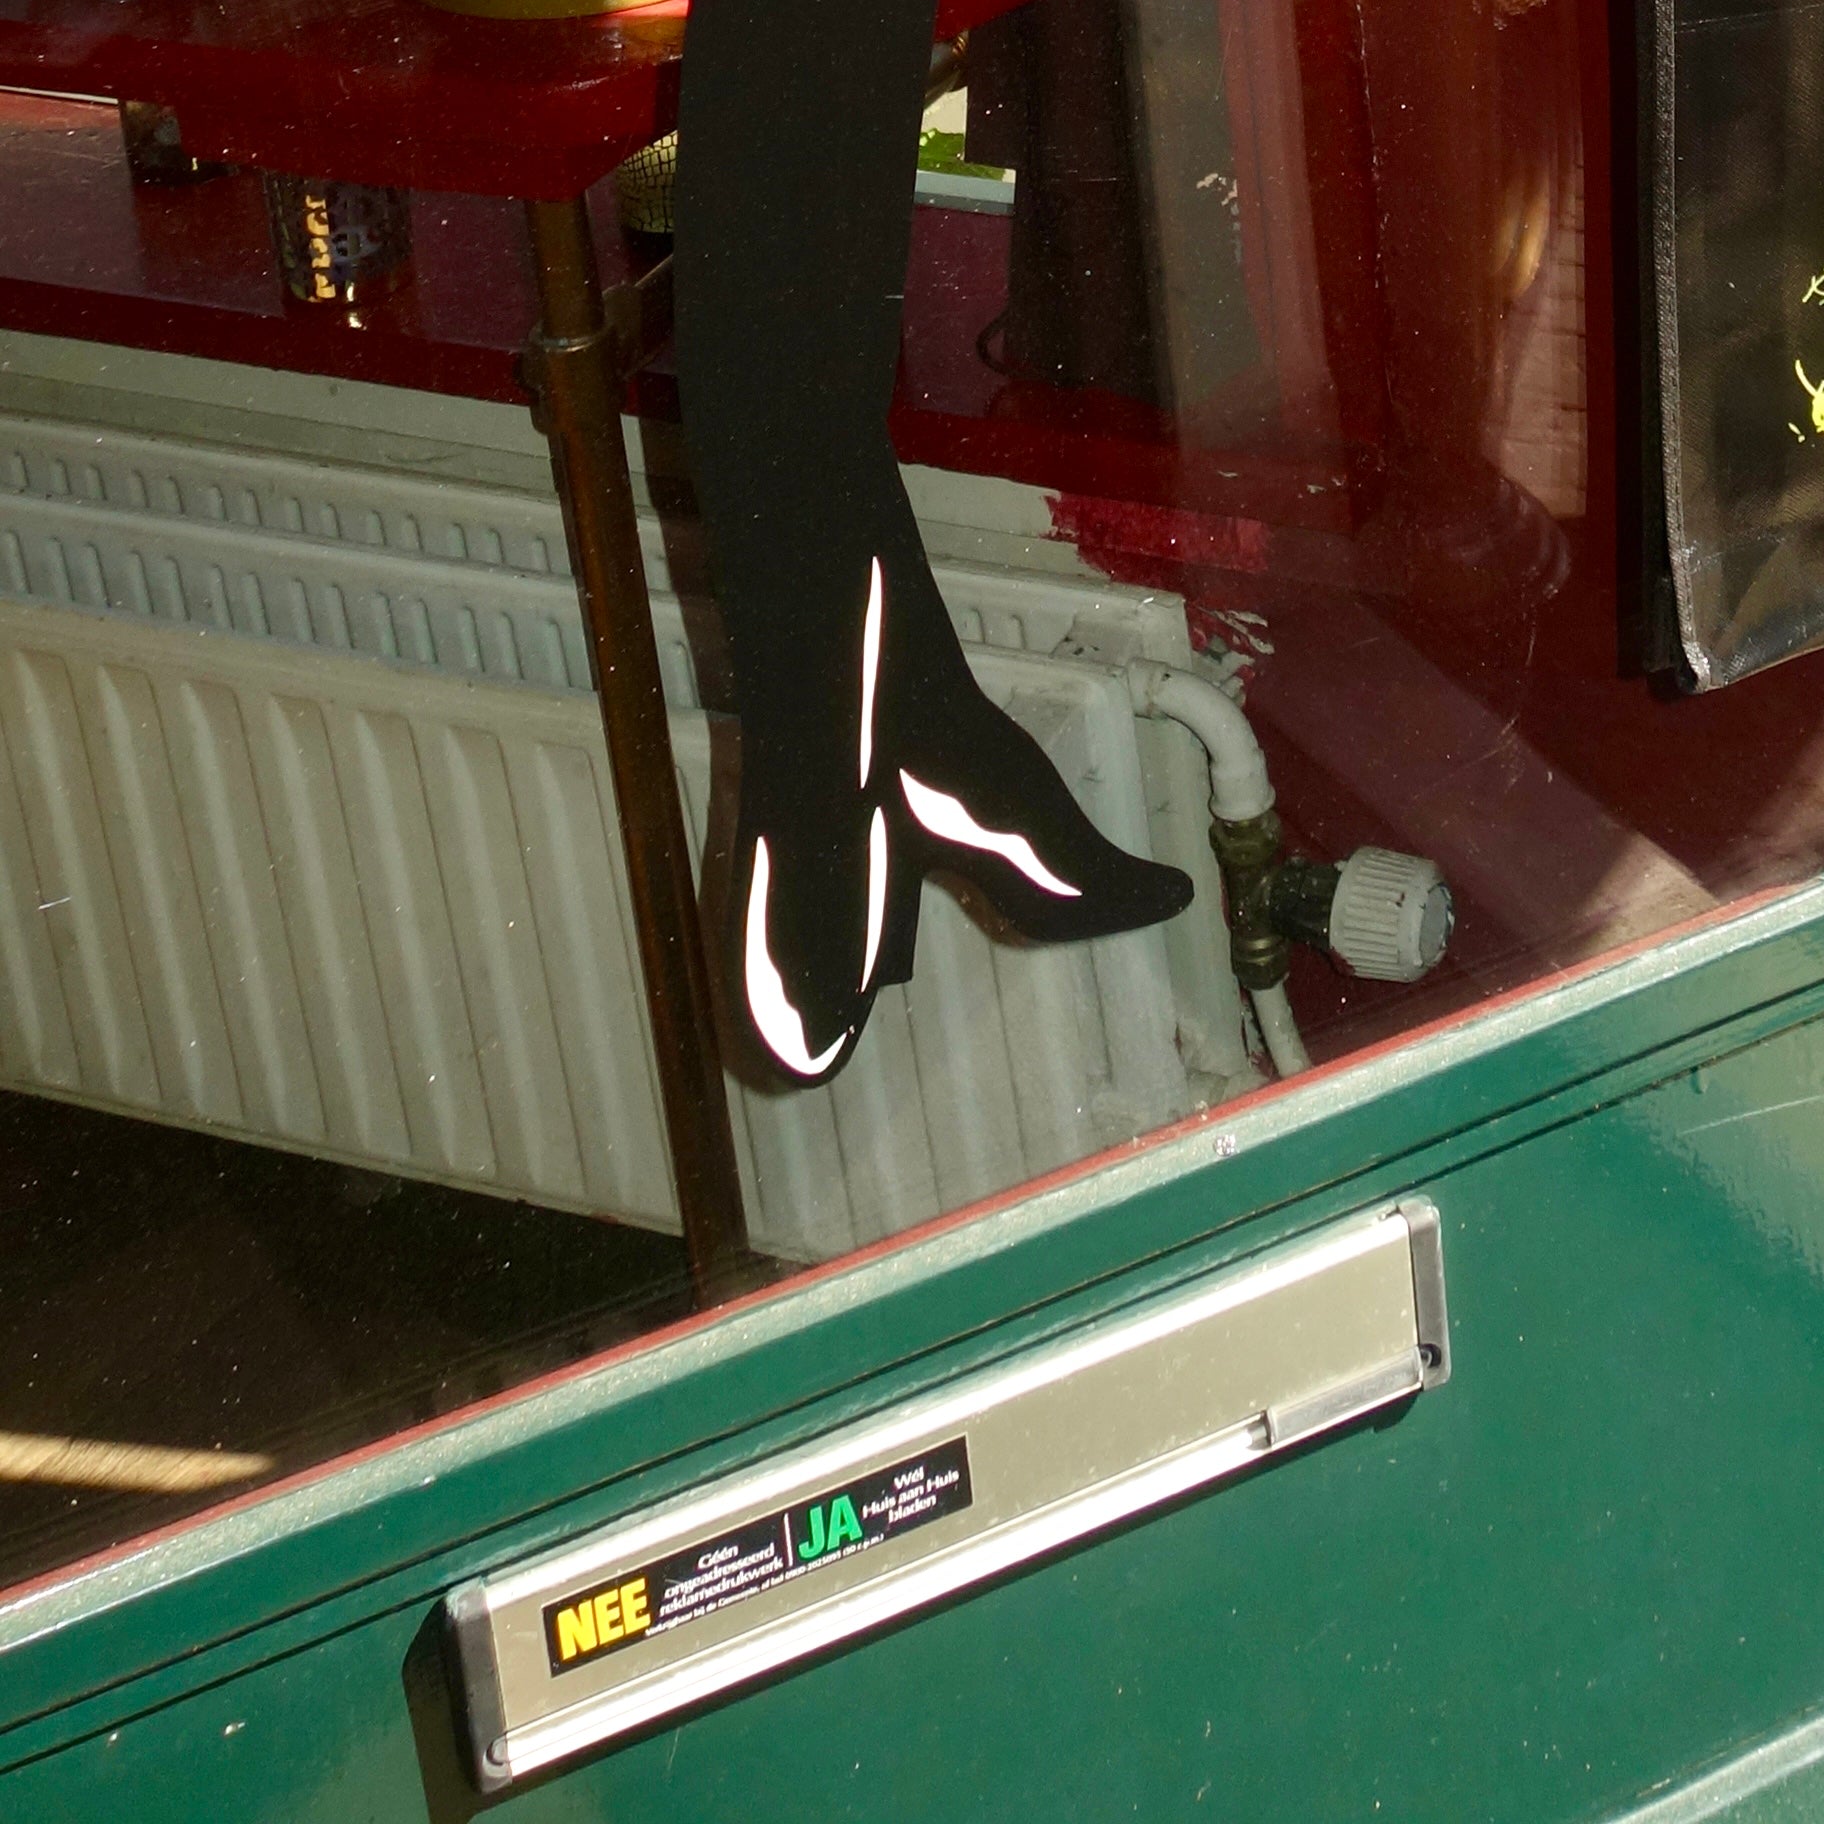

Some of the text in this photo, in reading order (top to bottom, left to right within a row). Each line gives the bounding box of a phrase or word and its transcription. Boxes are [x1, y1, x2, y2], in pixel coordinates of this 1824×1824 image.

[863, 1470, 960, 1519] Huis aan Huis
[888, 1494, 937, 1524] bladen
[798, 1494, 863, 1560] JA
[659, 1556, 784, 1617] reklamedrukwerk
[664, 1541, 775, 1599] ongeadresseerd
[556, 1577, 651, 1662] NEE
